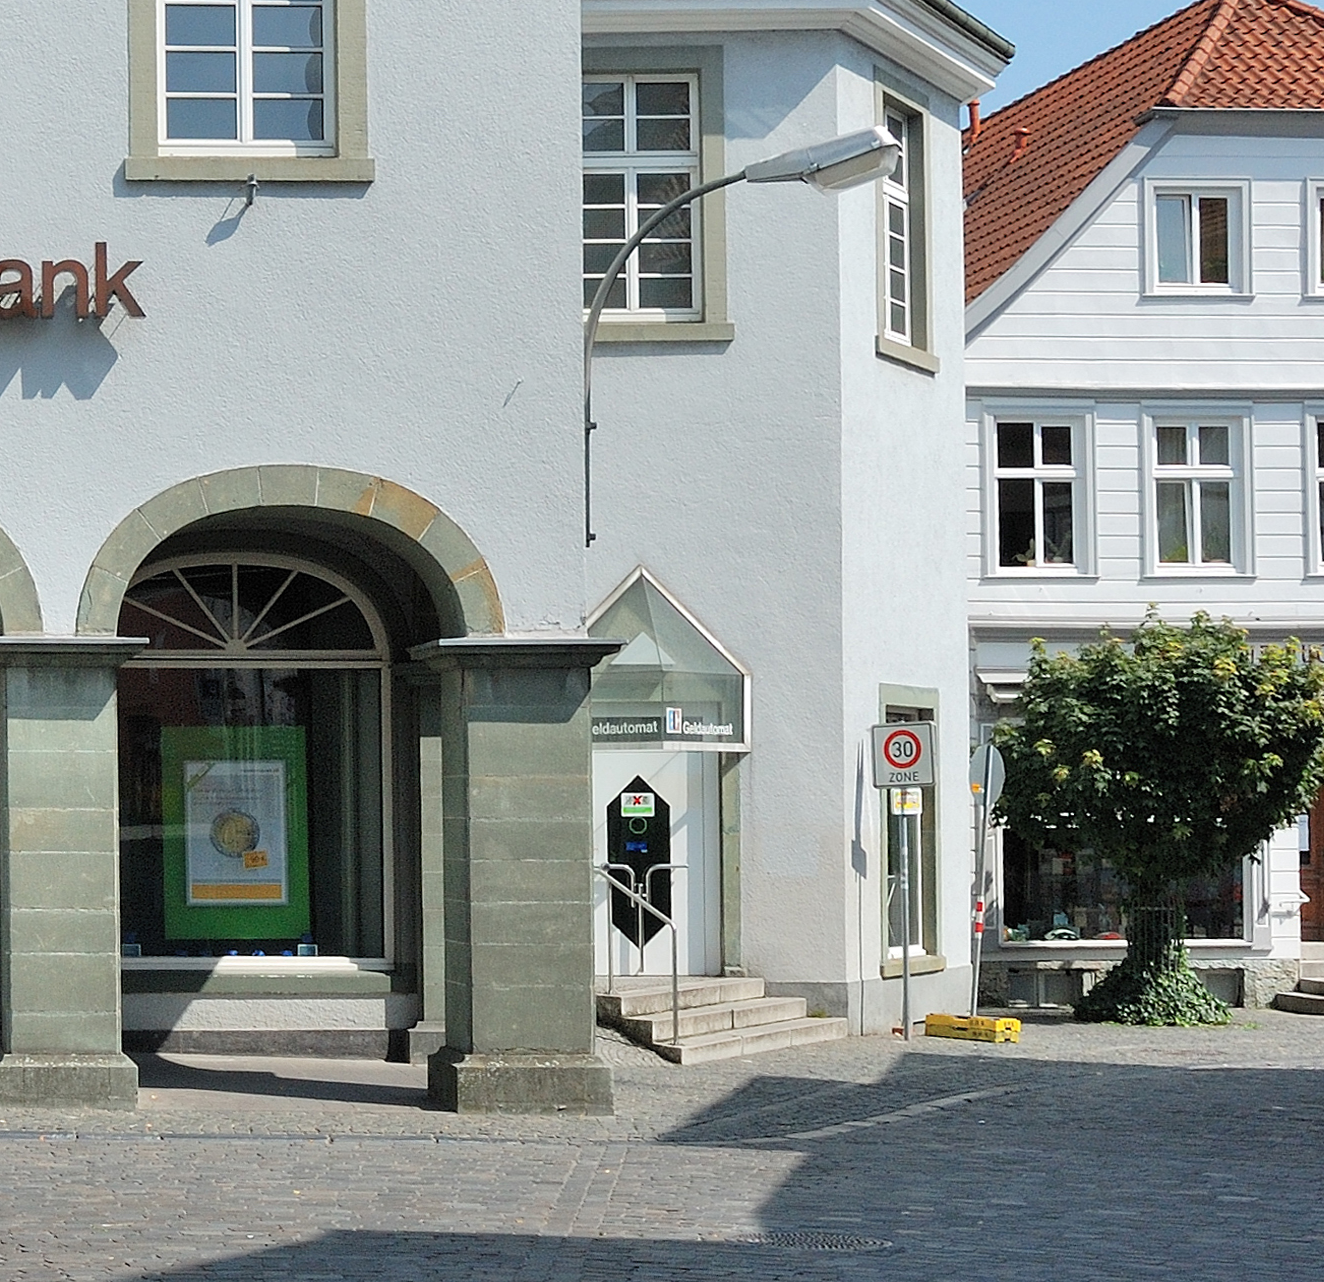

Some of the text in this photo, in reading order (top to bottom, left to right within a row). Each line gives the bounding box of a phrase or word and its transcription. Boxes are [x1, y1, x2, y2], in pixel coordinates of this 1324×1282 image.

[591, 721, 658, 735] eldautomat
[682, 721, 734, 735] Geldautomat
[892, 741, 913, 758] 30
[889, 771, 920, 782] ZONE
